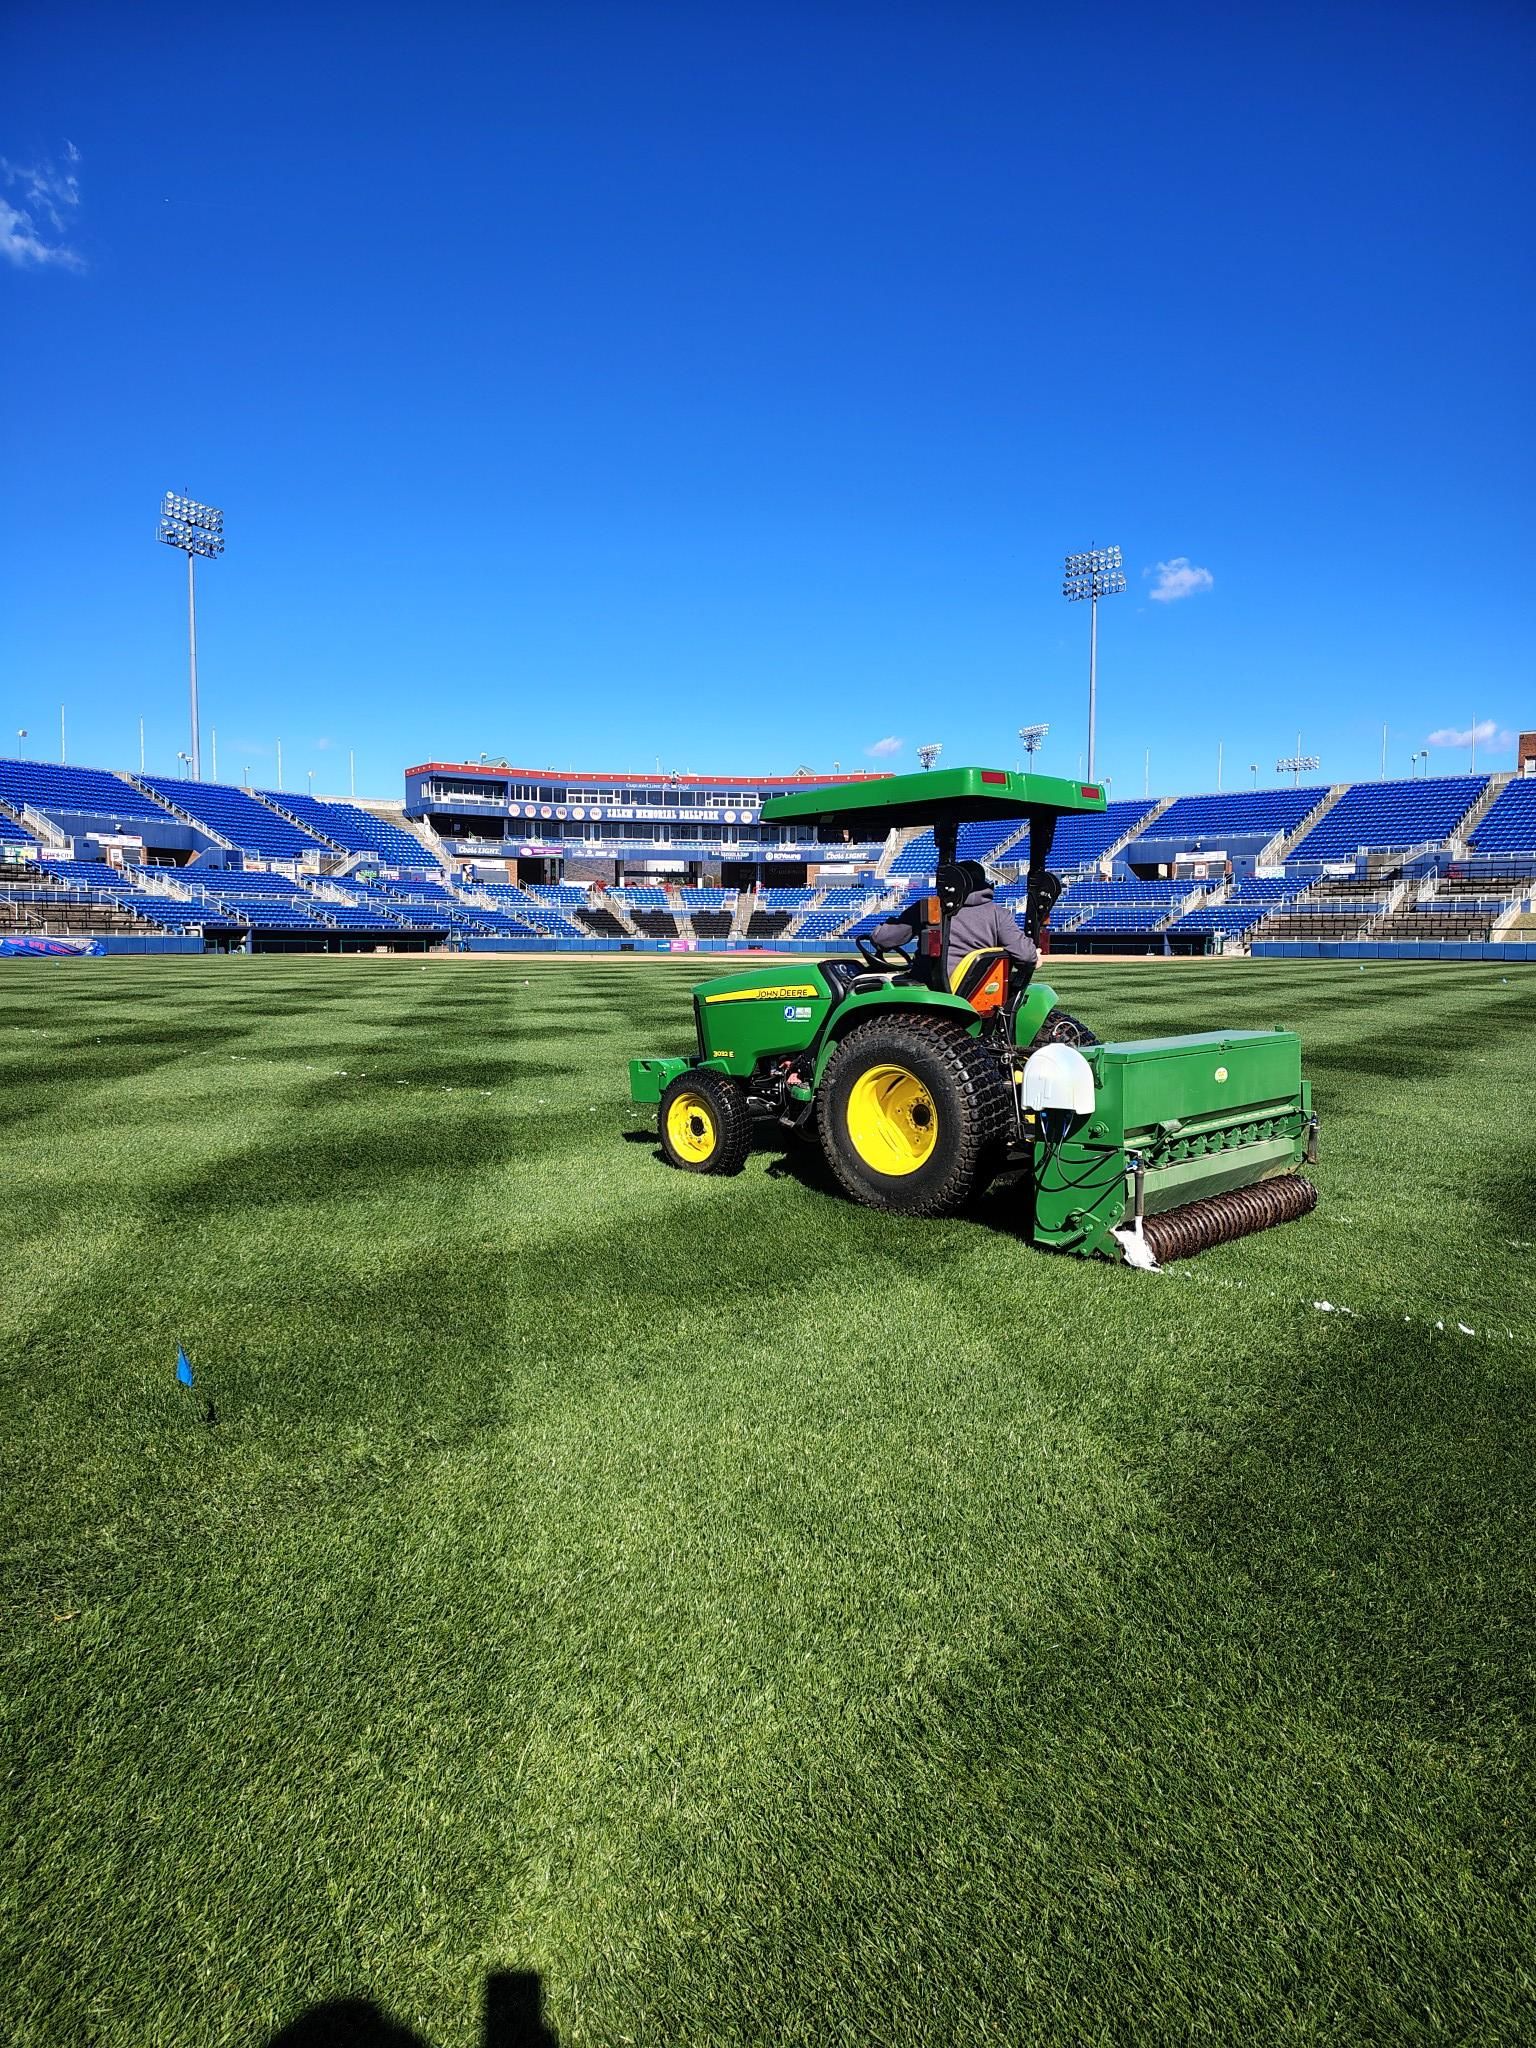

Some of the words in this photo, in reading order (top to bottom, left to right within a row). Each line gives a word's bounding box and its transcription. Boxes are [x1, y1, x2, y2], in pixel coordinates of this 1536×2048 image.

[607, 808, 633, 818] SALEM
[636, 809, 676, 819] MEMORIAL
[679, 810, 719, 820] BALLPARK
[458, 845, 478, 854] Coors
[826, 852, 845, 860] Coors
[756, 990, 778, 998] JOHN
[779, 988, 808, 997] DEERE
